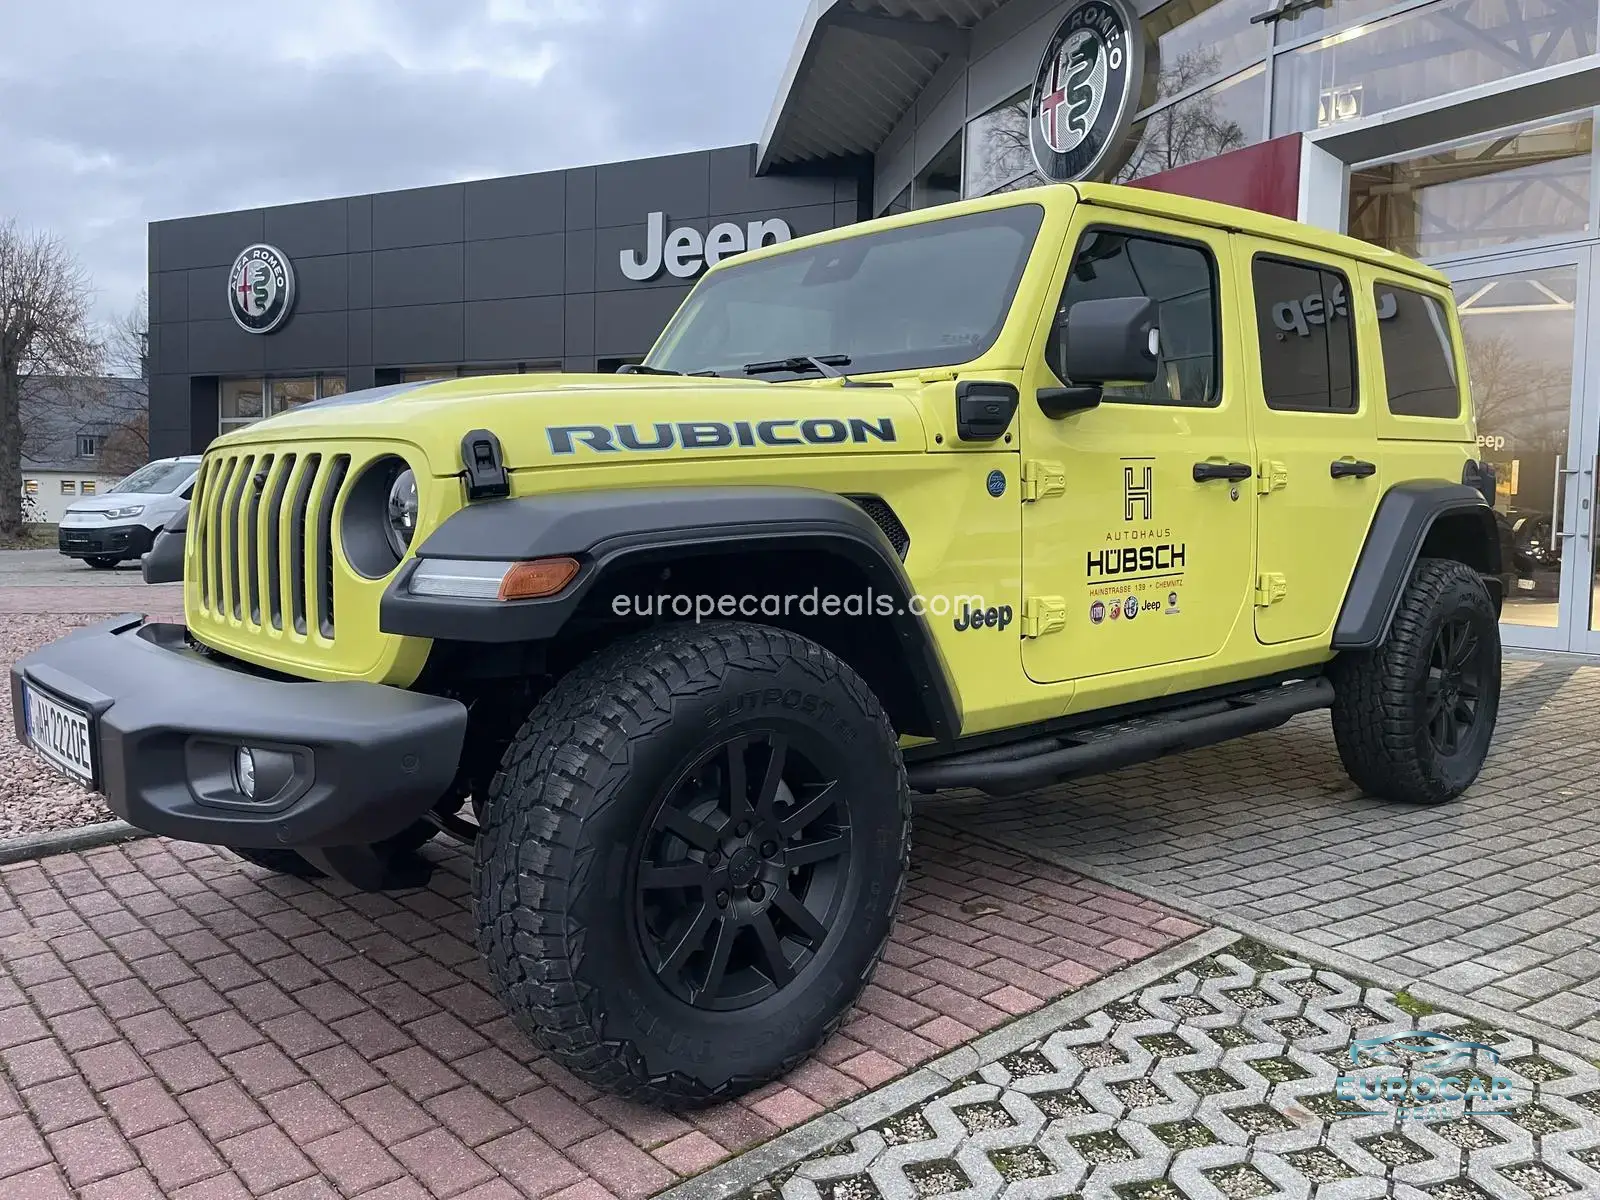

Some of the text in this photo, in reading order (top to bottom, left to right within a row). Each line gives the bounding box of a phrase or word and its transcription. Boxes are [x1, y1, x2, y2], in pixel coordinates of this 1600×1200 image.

[1070, 6, 1123, 70] ROMEO
[231, 250, 284, 290] ALFA ROMEO
[545, 418, 897, 454] RUBICON
[1475, 434, 1506, 449] eep
[1105, 528, 1171, 541] AUTOHAUS
[1087, 543, 1185, 576] HÜBSCH
[1089, 585, 1132, 597] HAINSTRASSE
[1155, 579, 1183, 589] CHEMNITZ
[953, 603, 1013, 632] Jeep
[1141, 599, 1161, 611] Jeep
